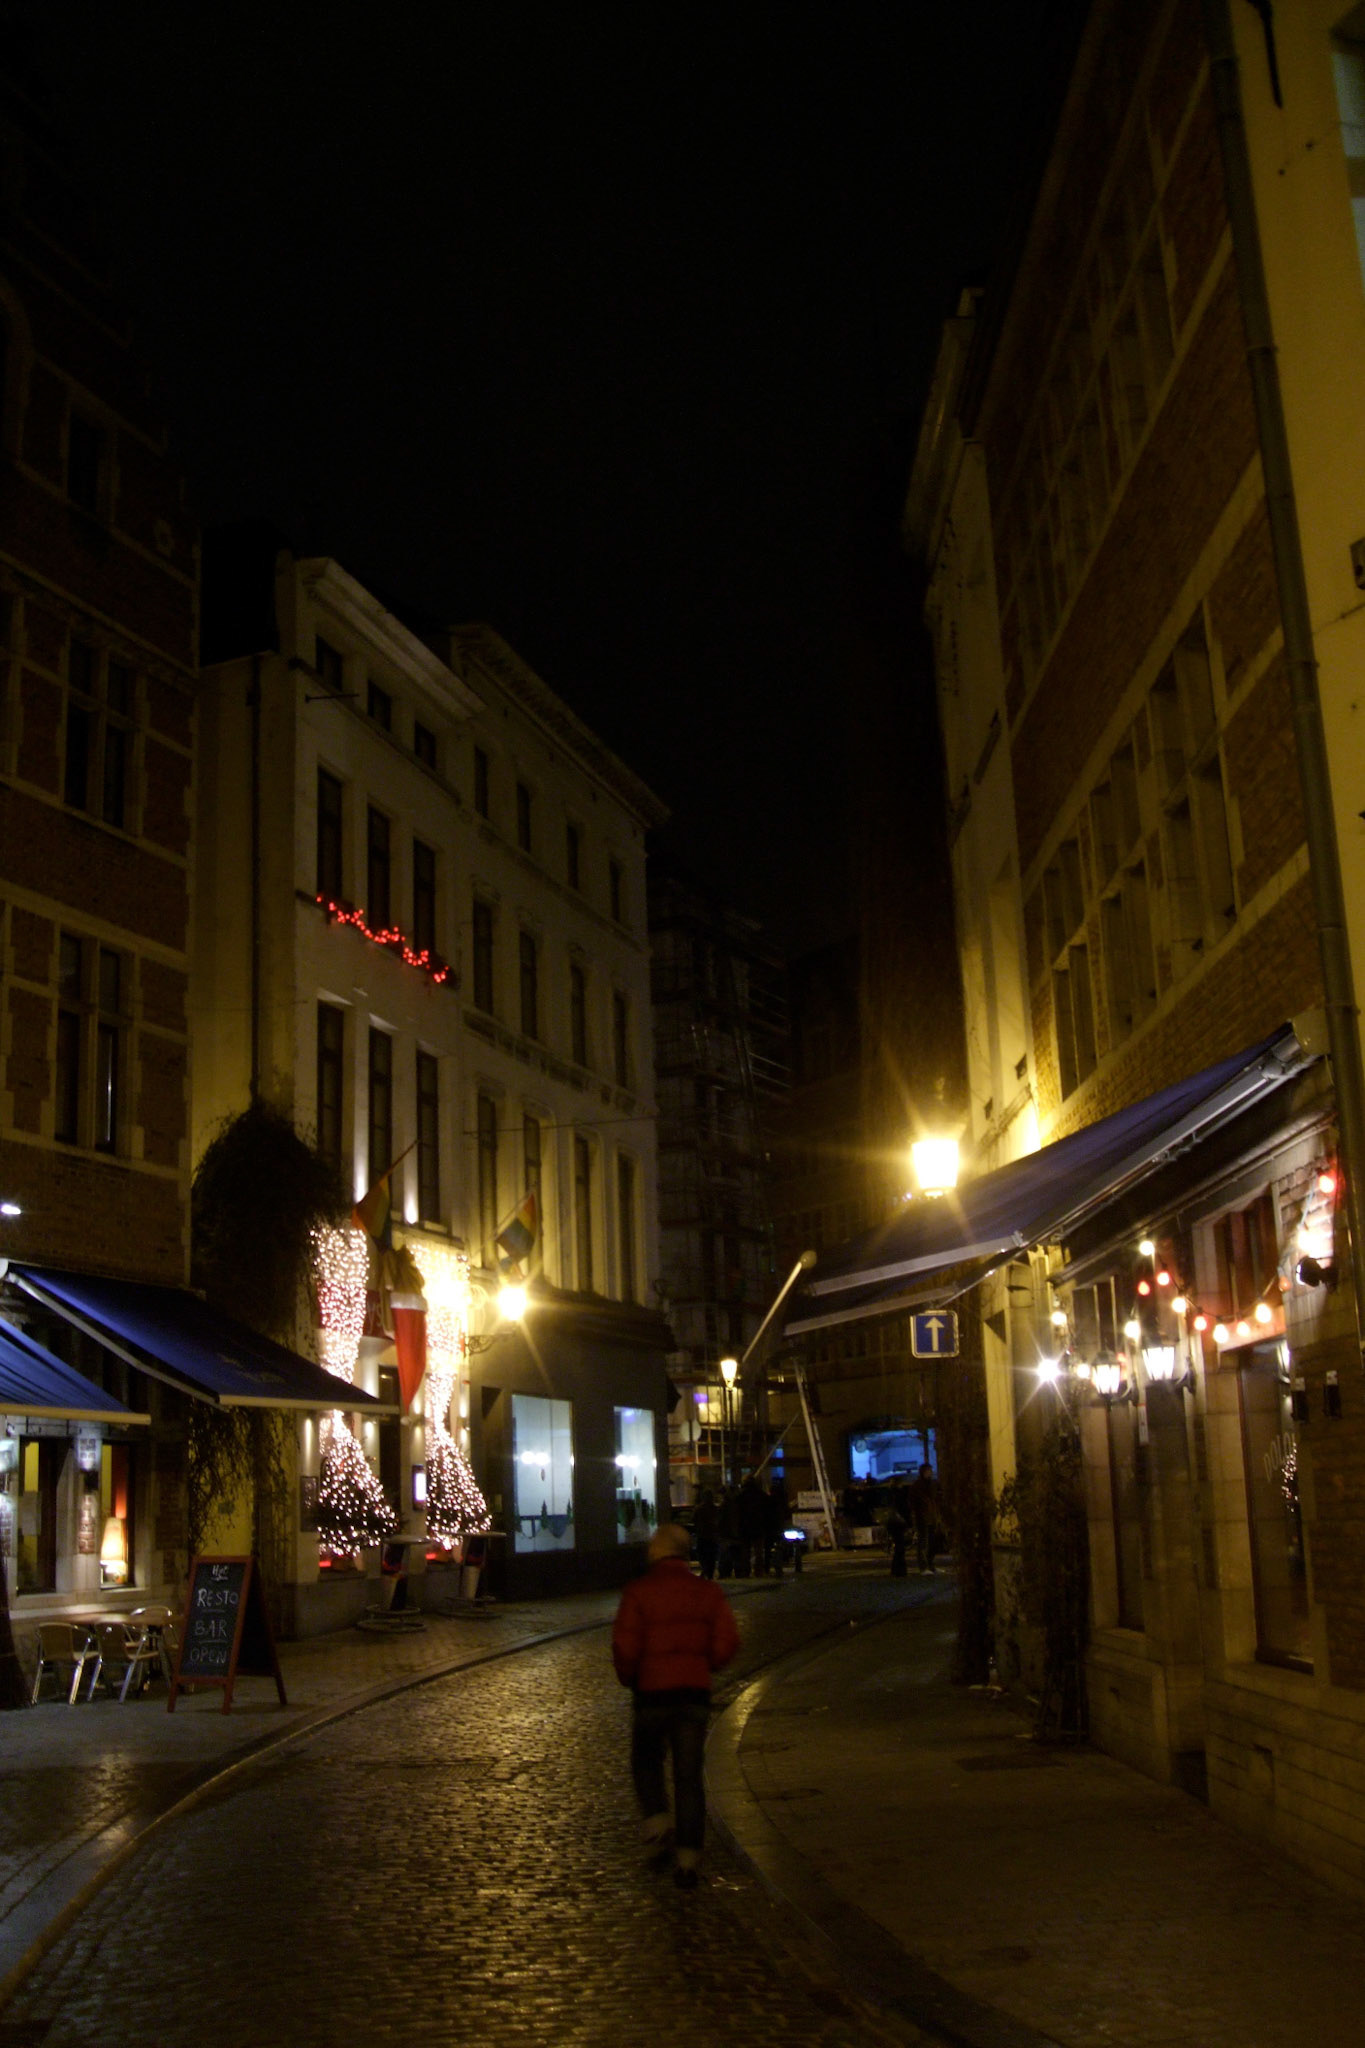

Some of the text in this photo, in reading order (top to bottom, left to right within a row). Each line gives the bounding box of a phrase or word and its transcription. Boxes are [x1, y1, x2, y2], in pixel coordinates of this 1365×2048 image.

[197, 1588, 239, 1607] RESTO
[194, 1619, 227, 1637] BAR
[190, 1647, 227, 1663] OPEN
